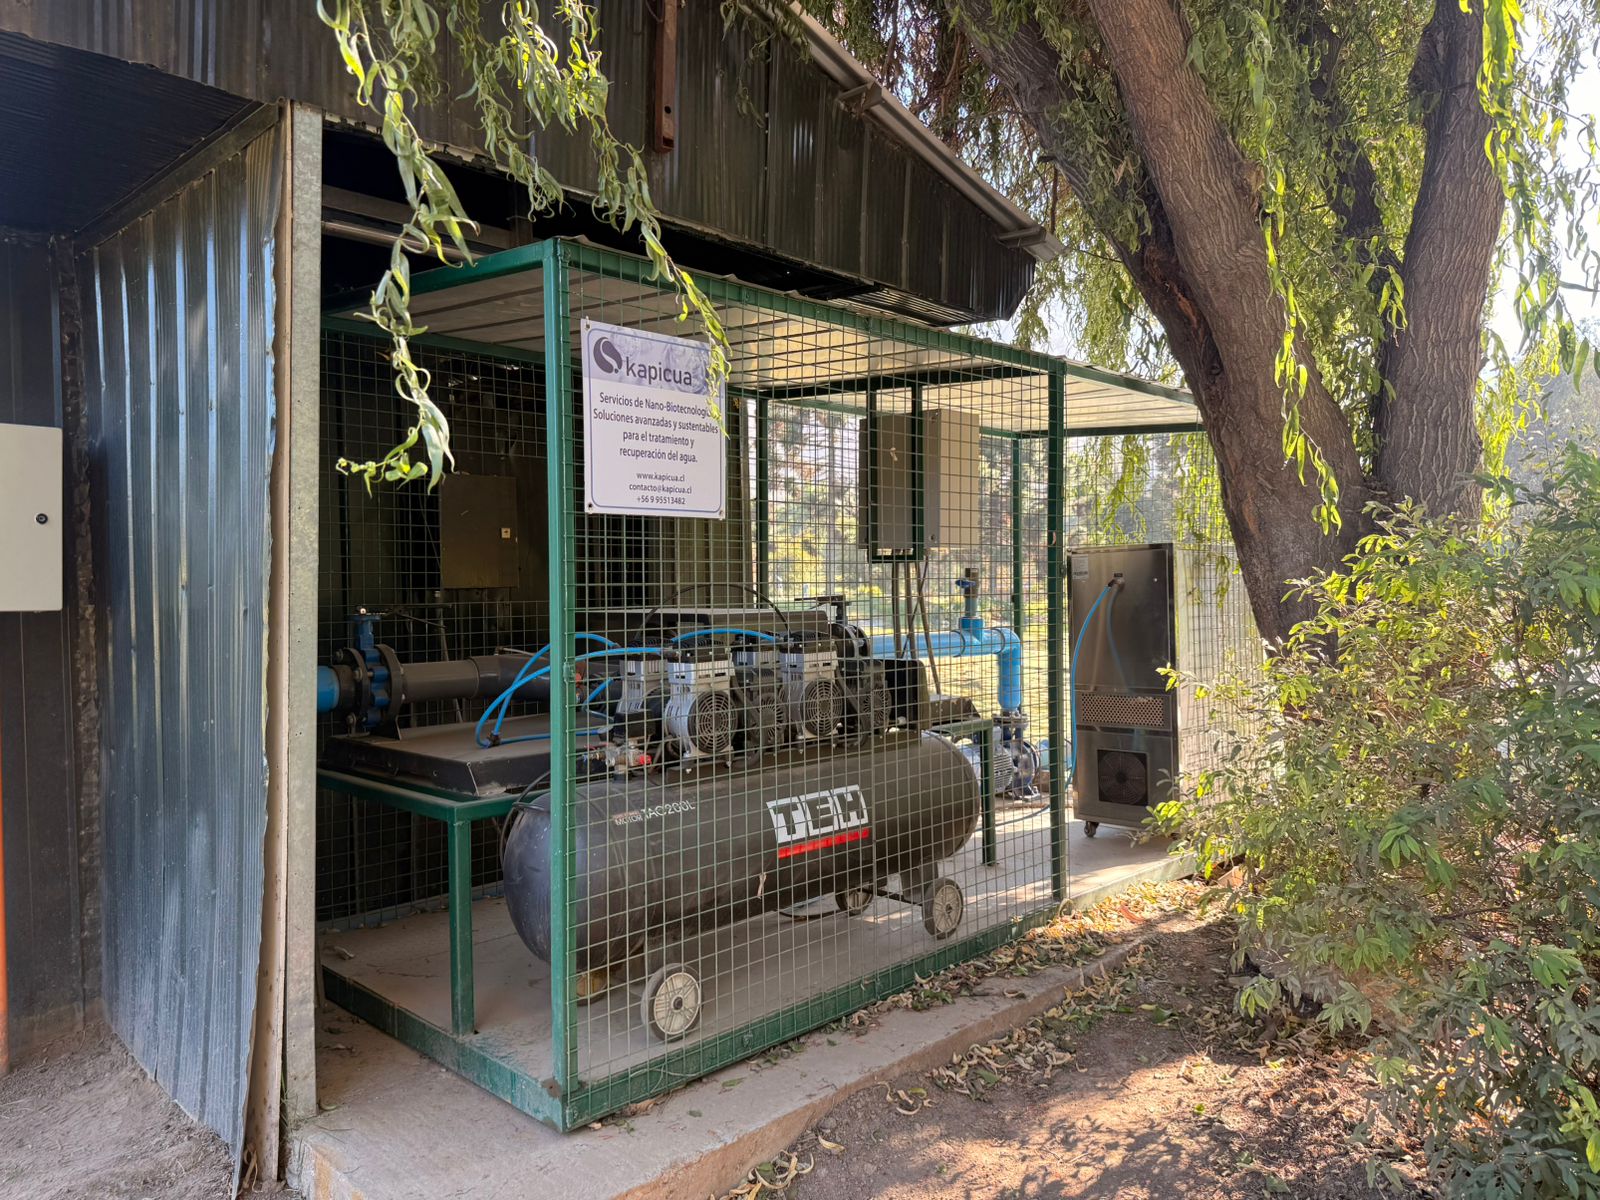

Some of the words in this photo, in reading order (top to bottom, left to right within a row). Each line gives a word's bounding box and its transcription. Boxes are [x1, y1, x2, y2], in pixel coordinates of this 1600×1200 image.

[626, 357, 692, 385] kapicua
[600, 392, 633, 407] Servicios
[634, 397, 643, 408] de
[645, 398, 714, 419] Nano-Biotecnologí
[593, 408, 633, 424] Soluciones
[635, 416, 672, 428] avanzadas
[673, 421, 678, 431] y
[678, 421, 718, 434] sustentables
[623, 431, 639, 442] para
[641, 431, 647, 442] el
[649, 433, 690, 446] tratamiento
[690, 438, 695, 449] y
[620, 447, 666, 459] recuperación
[668, 449, 678, 461] del
[679, 453, 698, 464] agua.
[636, 472, 685, 482] www.kapicua.cl
[637, 495, 649, 503] +56
